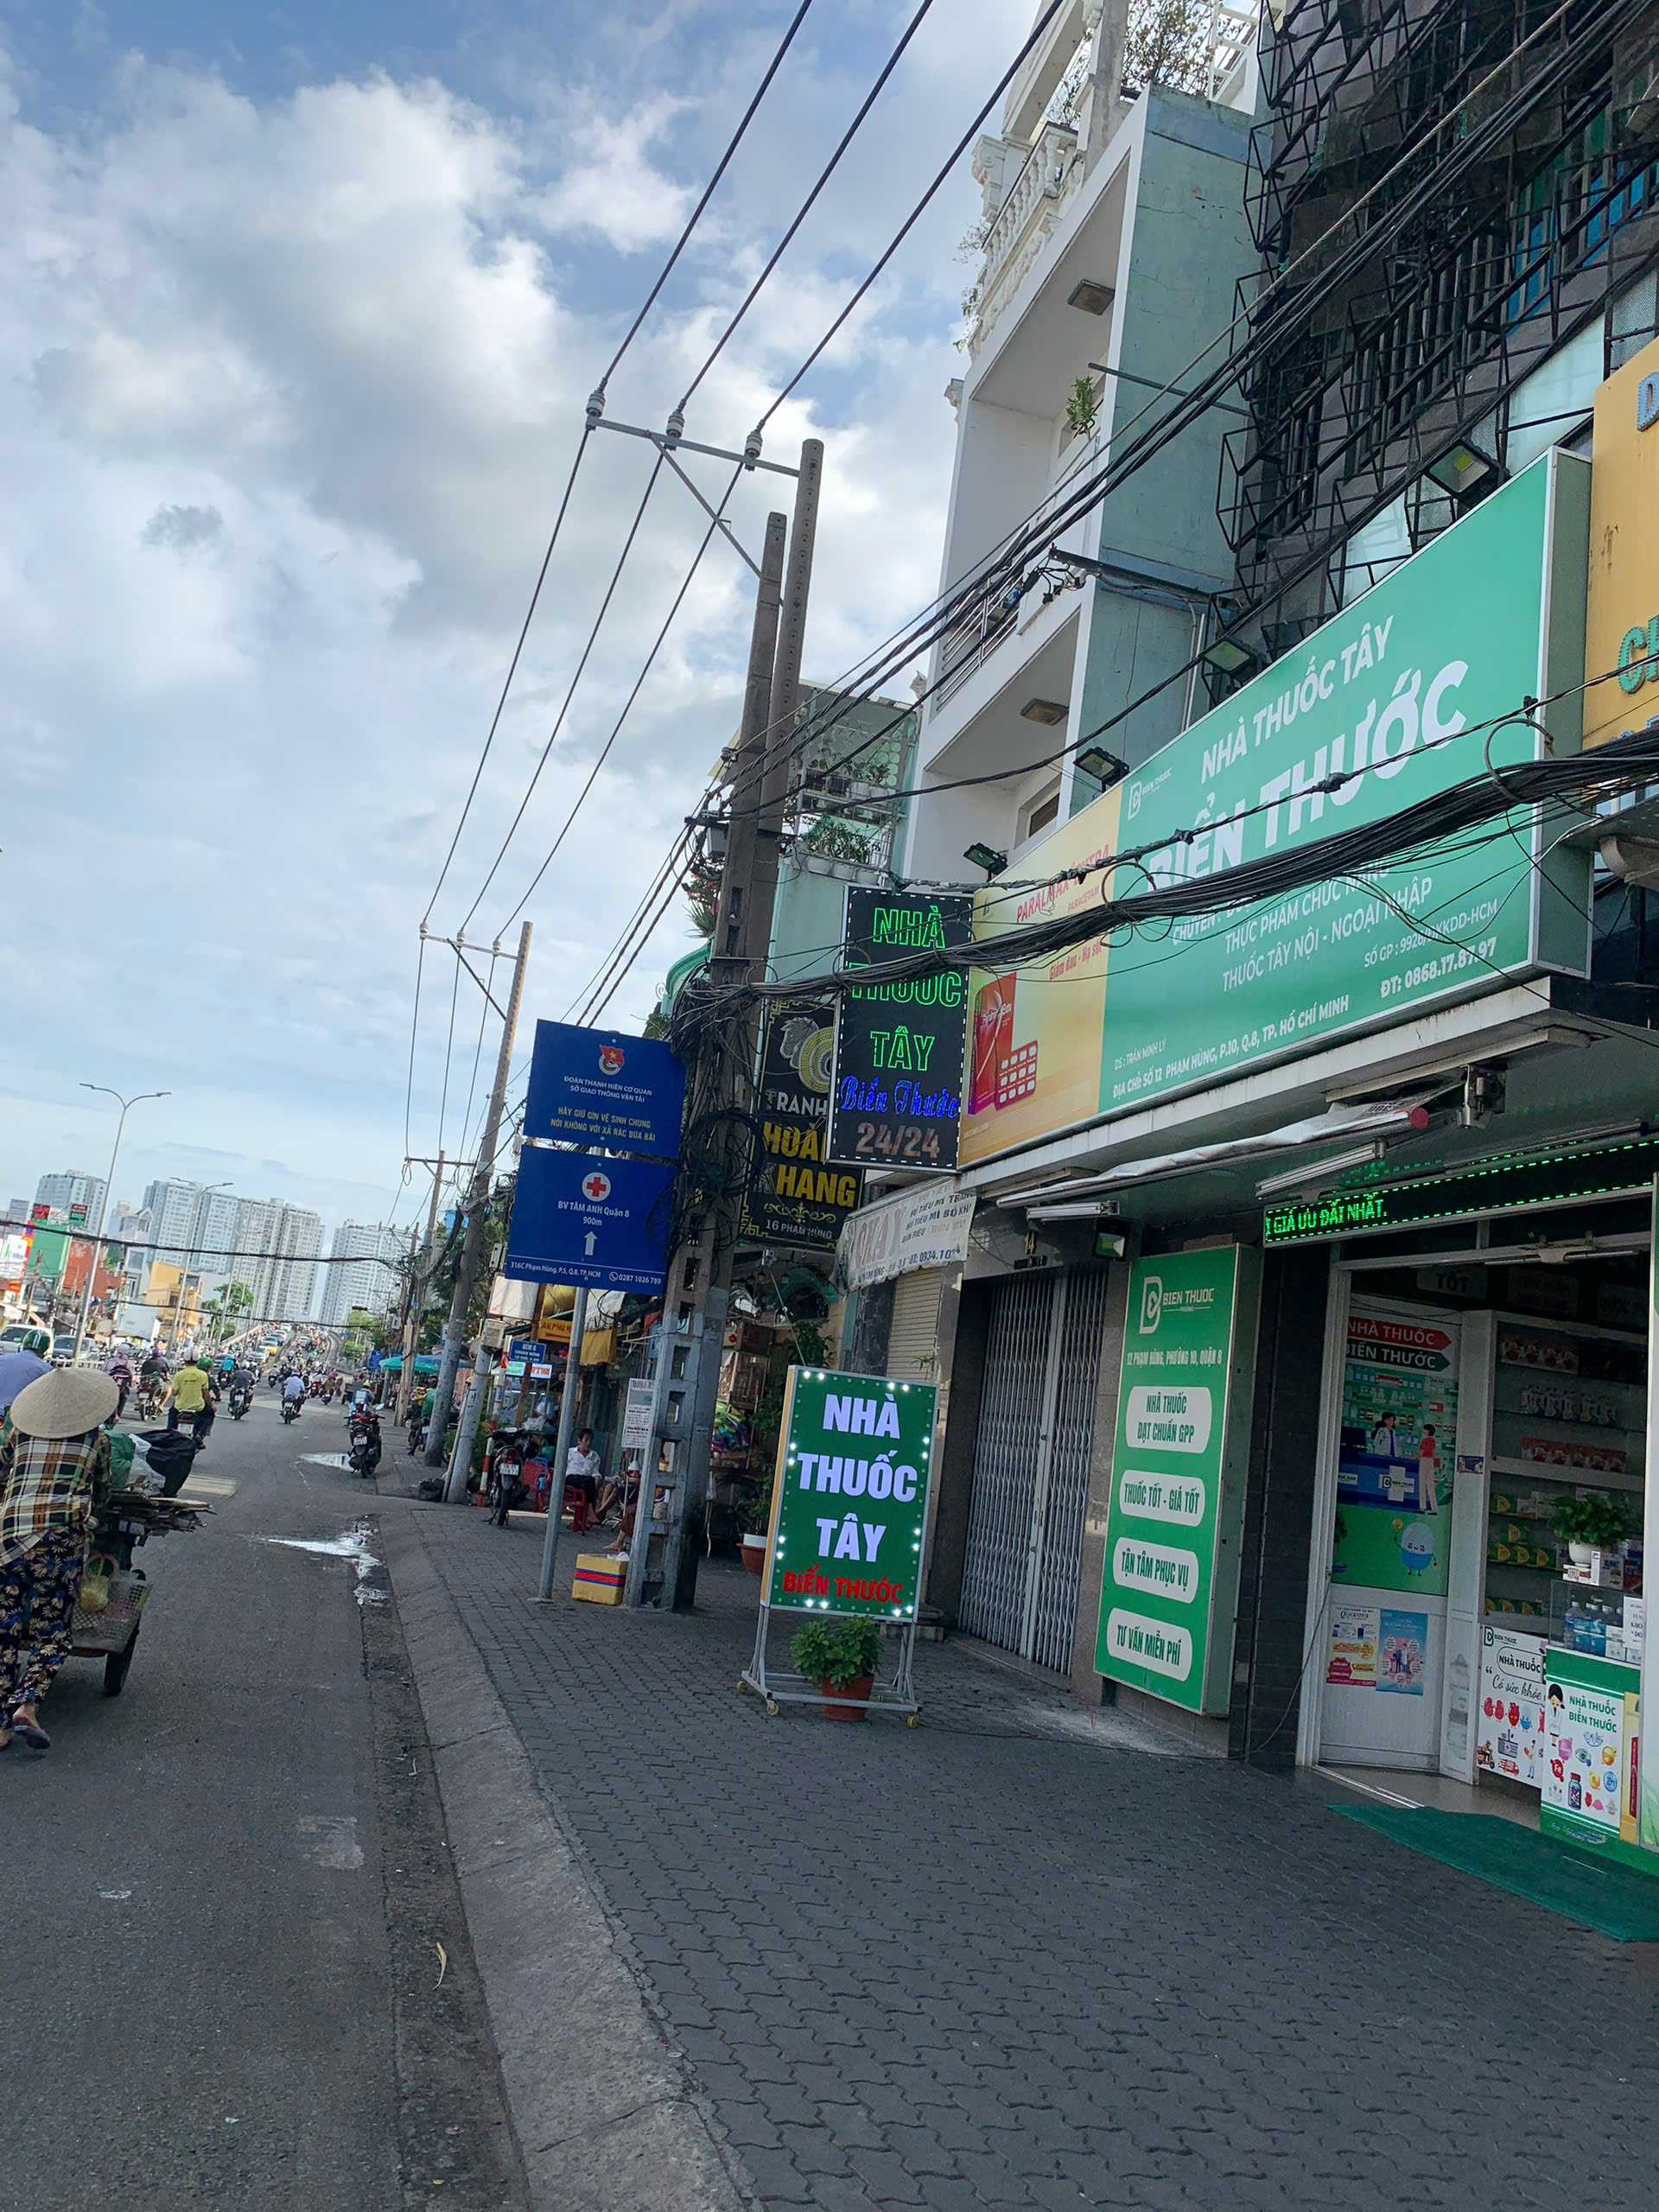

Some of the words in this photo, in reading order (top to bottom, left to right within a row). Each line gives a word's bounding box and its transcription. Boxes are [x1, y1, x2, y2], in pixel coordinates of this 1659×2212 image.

[1199, 722, 1249, 785] NHÀ
[1252, 654, 1335, 745] THUỐC
[1340, 614, 1395, 685] TÂY
[1147, 791, 1248, 893] BIỂN
[1258, 658, 1470, 850] THƯỚC
[872, 906, 946, 950] NHÀ
[1223, 952, 1264, 993] THUỐC
[1268, 943, 1292, 971] TÂY
[1294, 926, 1319, 961] NỘI
[1331, 902, 1381, 944] NGOẠI
[1382, 876, 1433, 918] NHẬP
[1225, 918, 1257, 954] THỰC
[1364, 944, 1377, 968] SỐ
[1380, 975, 1402, 998] ĐT:
[1404, 937, 1497, 988] 0868.17.87.97
[869, 1025, 935, 1071] TÂY
[1113, 1082, 1126, 1101] ĐỊA
[1142, 1065, 1155, 1088] SỐ
[1155, 1066, 1162, 1083] 12
[1166, 1056, 1190, 1079] PHẠM
[1191, 1046, 1218, 1071] HÙNG,
[1219, 1038, 1240, 1058] P.10,
[1241, 1030, 1260, 1052] Q.8,
[1262, 1023, 1278, 1042] TP.
[1280, 1008, 1295, 1037] HỒ
[1297, 1001, 1317, 1028] CHÍ
[1319, 994, 1350, 1020] MINH
[1141, 1044, 1158, 1060] MINH
[563, 1076, 583, 1084] ĐOÀN
[584, 1077, 607, 1088] THANH
[607, 1083, 623, 1091] NIÊN
[633, 1087, 652, 1096] QUAN
[597, 1089, 620, 1099] THÔNG
[620, 1093, 634, 1102] VẬN
[558, 1106, 574, 1116] HÃY
[574, 1109, 586, 1118] GIỮ
[588, 1111, 600, 1121] GÌN
[601, 1113, 609, 1123] VỆ
[611, 1115, 627, 1124] SINH
[628, 1118, 651, 1128] CHUNG
[564, 1120, 588, 1131] KHÔNG
[589, 1123, 601, 1134] VỚI
[613, 1128, 626, 1137] RÁC
[855, 1122, 940, 1159] 24/24
[754, 1163, 857, 1208] KHANG
[557, 1200, 569, 1210] BV
[569, 1202, 586, 1211] TÂM
[587, 1205, 603, 1214] ANH
[603, 1207, 624, 1217] Quận
[582, 1217, 602, 1226] 900m
[766, 1219, 779, 1230] 16
[781, 1223, 806, 1236] PHẠM
[511, 1262, 525, 1270] 316C
[524, 1262, 541, 1273] Phạm
[541, 1265, 557, 1274] Hùng,
[618, 1274, 633, 1282] 0287
[634, 1274, 650, 1283] 1026
[650, 1276, 662, 1285] 789
[1162, 1289, 1185, 1306] BIEN
[1185, 1287, 1215, 1303] THUOC
[1348, 1319, 1379, 1336] NHÀ
[1382, 1325, 1435, 1345] THUỐC
[1133, 1351, 1148, 1369] PHẠM
[1217, 1349, 1223, 1364] 8
[1381, 1349, 1436, 1369] THƯỚC
[1146, 1391, 1161, 1413] NHÀ
[1163, 1391, 1187, 1414] THUỐC
[823, 1393, 900, 1440] NHÀ
[1137, 1421, 1152, 1443] ĐẠT
[1179, 1424, 1195, 1443] GPP
[798, 1450, 918, 1503] THUỐC
[1124, 1480, 1147, 1506] THUỐC
[1148, 1482, 1162, 1508] TỐT
[1169, 1485, 1183, 1512] GIÁ
[1185, 1487, 1200, 1514] TỐT
[816, 1512, 887, 1563] TÂY
[1122, 1548, 1135, 1577] TẬN
[1136, 1549, 1154, 1579] TÂM
[1154, 1559, 1176, 1588] PHỤC
[1178, 1563, 1190, 1592] VỤ
[834, 1575, 905, 1605] THƯỚC
[1116, 1624, 1128, 1647] TƯ
[1128, 1625, 1144, 1654] VẤN
[1144, 1630, 1166, 1661] MIỄN
[1166, 1638, 1182, 1667] PHÍ
[1498, 1654, 1515, 1667] NHÀ
[1516, 1656, 1541, 1674] THUỐC
[1492, 1675, 1504, 1689] Có
[1569, 1694, 1586, 1707] NHÀ
[1588, 1699, 1616, 1716] THUỐC
[1588, 1717, 1618, 1733] THƯỚC
